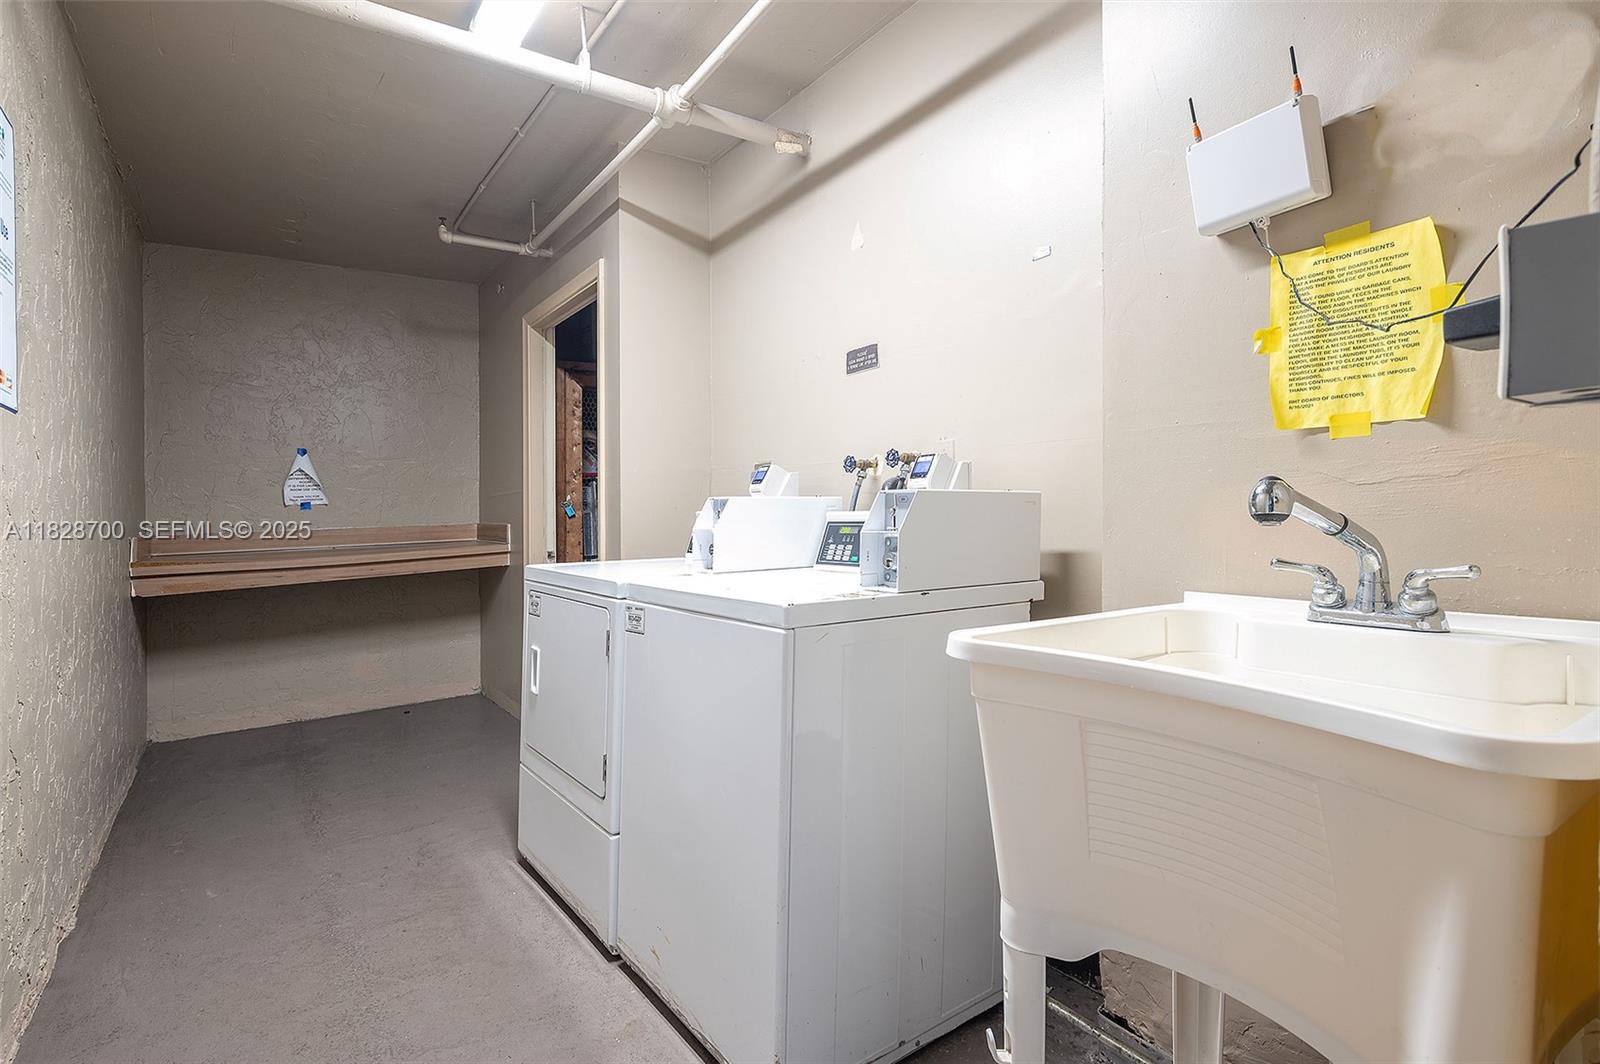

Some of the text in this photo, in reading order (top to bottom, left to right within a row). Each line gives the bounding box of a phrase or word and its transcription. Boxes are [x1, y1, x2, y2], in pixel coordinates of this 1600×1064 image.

[1313, 242, 1395, 266] ATTENTION RESIDENTS
[1374, 251, 1409, 264] ATTENTION
[1309, 274, 1336, 284] HANDFUL
[1346, 264, 1379, 276] RESIDENTS
[1327, 275, 1356, 286] PRIVILEGE
[1366, 269, 1381, 277] OUR
[1381, 263, 1412, 274] LAUNDRY
[1314, 290, 1336, 299] FOUND
[1361, 279, 1390, 290] GARBAGE
[1352, 290, 1371, 298] FECES
[1366, 290, 1399, 301] MACHINES
[1400, 285, 1422, 294] WHICH
[1336, 308, 1368, 318] CIGARETTE
[1369, 304, 1390, 312] BUTTS
[1390, 306, 1412, 315] WHOLE
[1289, 329, 1314, 338] LAUNDRY
[1316, 325, 1334, 333] ROOM
[1300, 331, 1328, 341] LAUNDRY
[1328, 328, 1351, 336] ROOMS
[1369, 332, 1398, 342] LAUNDRY
[1289, 351, 1316, 360] WHETHER
[1339, 349, 1368, 358] LAUNDRY
[1289, 359, 1334, 370] RESPONSIBILITY
[1374, 351, 1394, 360] AFTER
[1289, 367, 1317, 376] YOURSELF
[1340, 359, 1379, 369] RESPECTFUL
[1330, 391, 1365, 400] DIRECTORS
